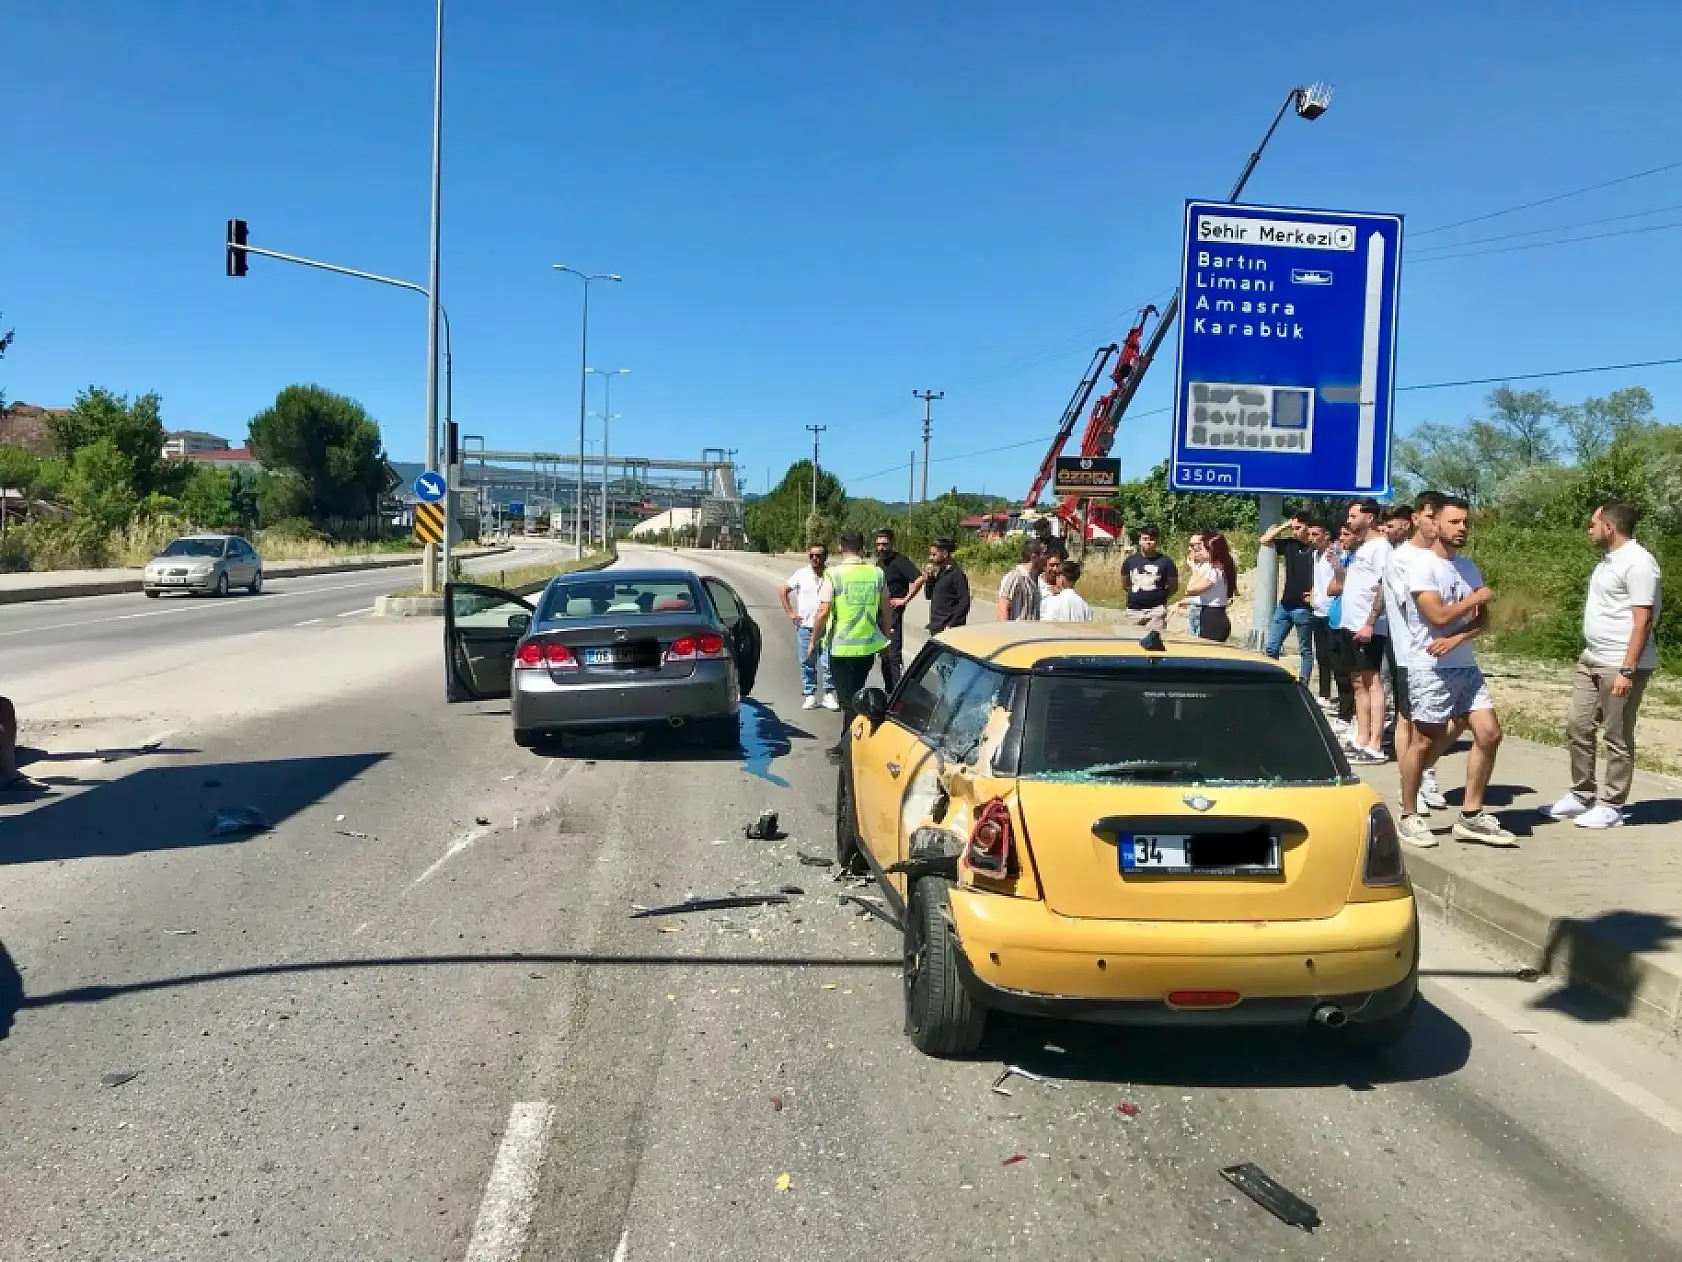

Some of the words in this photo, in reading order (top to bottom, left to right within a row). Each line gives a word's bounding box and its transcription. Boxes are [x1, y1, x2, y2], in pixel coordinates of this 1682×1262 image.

[1200, 221, 1248, 239] Şehir
[1260, 225, 1332, 246] Merkezi
[1197, 252, 1267, 271] Bartın
[1196, 272, 1274, 292] Limanı
[1195, 294, 1295, 316] Amasra
[1193, 318, 1304, 339] Karabük
[1182, 468, 1233, 483] 350m
[1135, 837, 1163, 864] 34
